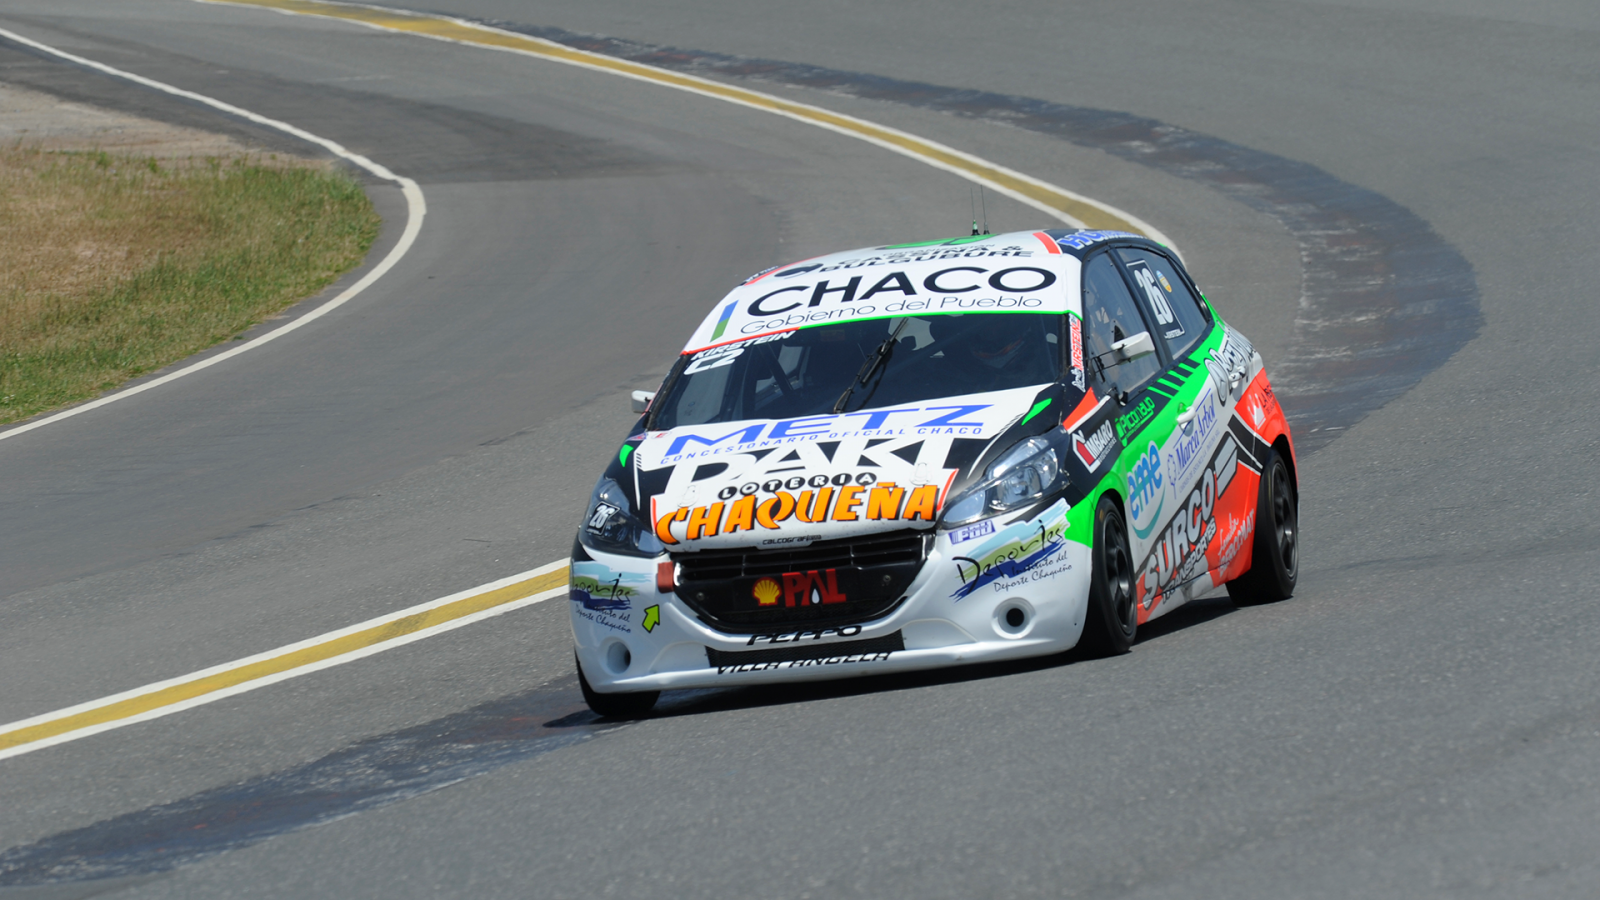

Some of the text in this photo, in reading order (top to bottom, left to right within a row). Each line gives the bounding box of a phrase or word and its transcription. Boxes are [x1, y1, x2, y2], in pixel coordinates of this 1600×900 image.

[747, 266, 1057, 316] CHACO
[1134, 267, 1174, 325] 26
[740, 295, 1042, 334] Gobierno del Pueblo
[690, 330, 796, 361] KIRSTEIN
[660, 434, 818, 465] CONCESIONARIO
[829, 428, 905, 439] OFICIAL
[917, 426, 982, 436] CHACO
[664, 404, 995, 456] METZ
[718, 472, 877, 500] LOTERIA
[588, 504, 616, 529] 26
[656, 482, 940, 545] CHAQUEÑA
[1056, 550, 1068, 563] del
[1142, 467, 1215, 611] SURCO
[782, 568, 847, 607] PAL
[993, 563, 1073, 593] Deporte Chaqueño
[746, 625, 863, 646] PEPPO
